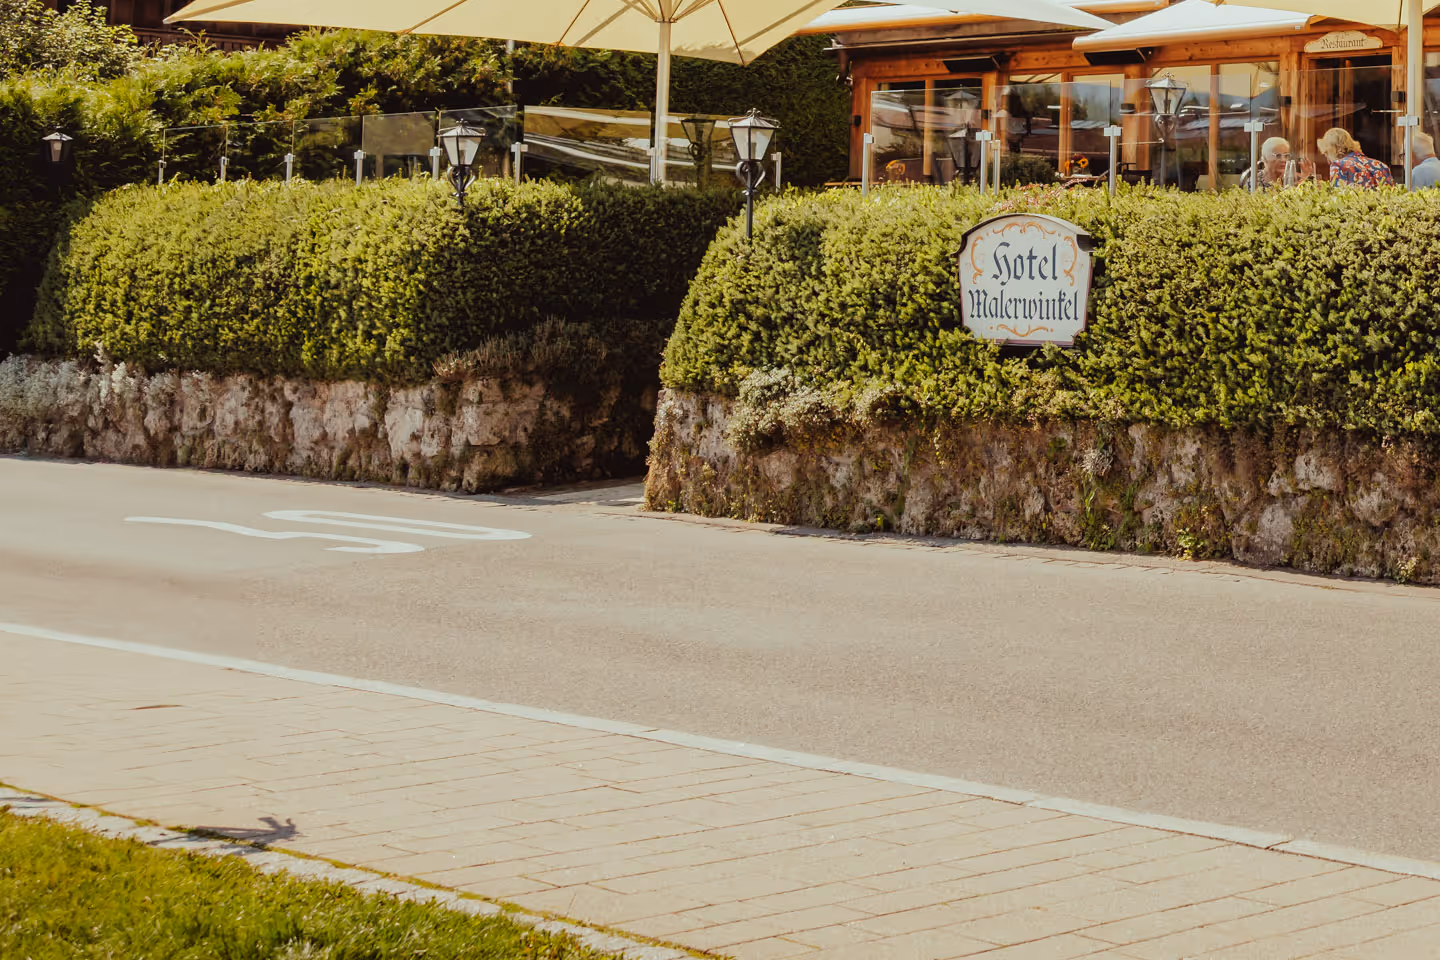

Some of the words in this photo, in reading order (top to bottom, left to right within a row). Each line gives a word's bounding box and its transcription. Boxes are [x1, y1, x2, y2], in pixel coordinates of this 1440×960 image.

[1321, 38, 1365, 49] Restaurant
[991, 241, 1058, 286] Hotel
[968, 289, 1079, 321] Malerwinkel
